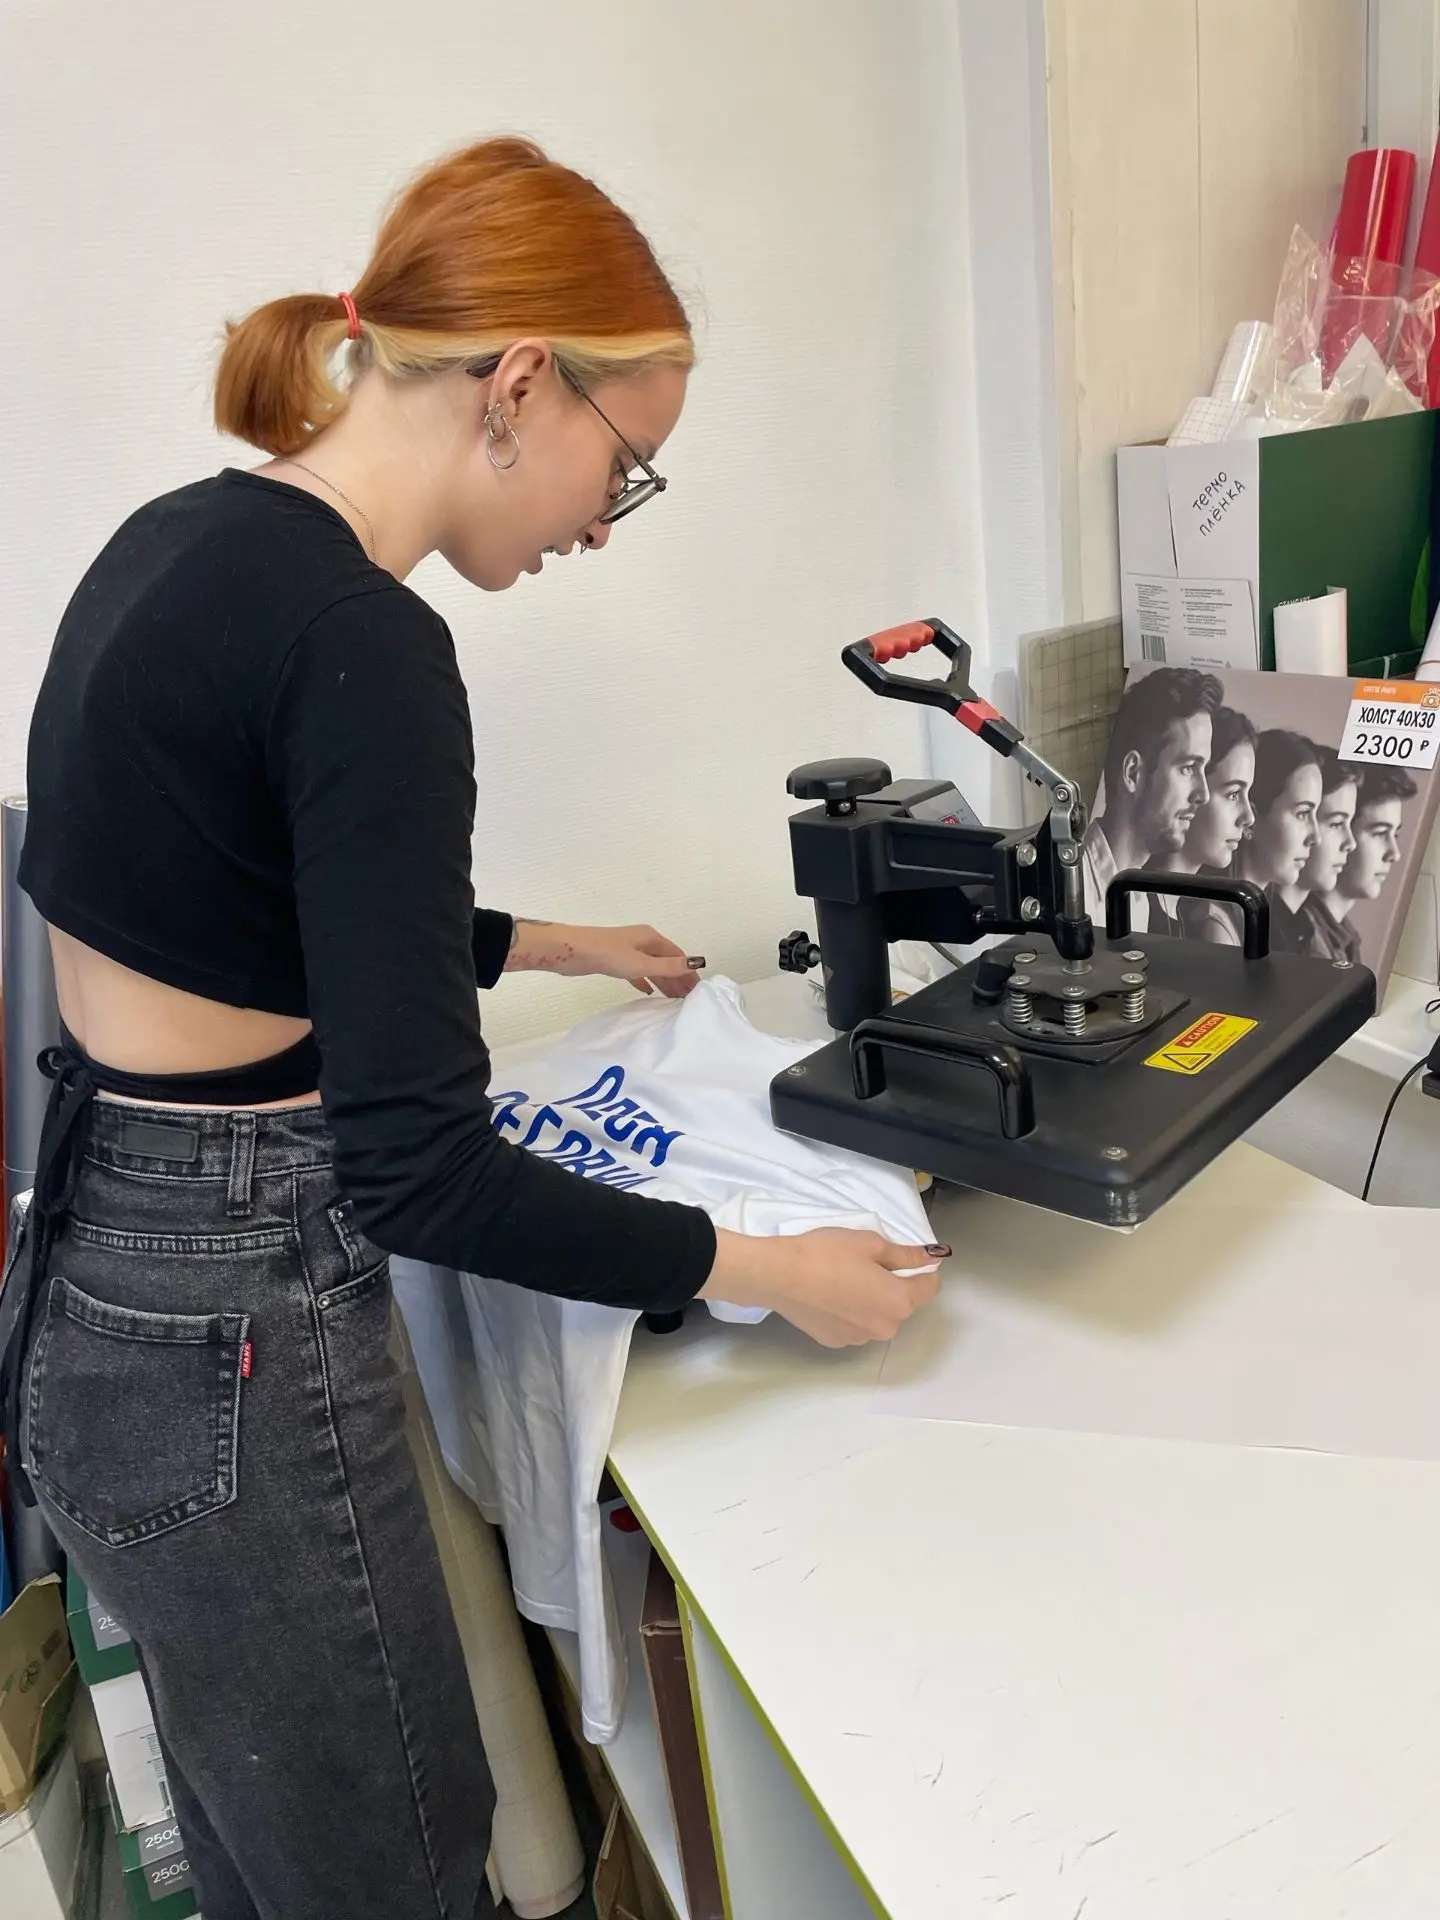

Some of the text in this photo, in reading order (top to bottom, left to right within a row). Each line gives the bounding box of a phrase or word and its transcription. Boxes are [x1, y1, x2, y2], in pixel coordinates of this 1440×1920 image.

[1358, 706, 1397, 726] ХОЛСТ
[1352, 733, 1413, 760] 2300
[1188, 1015, 1222, 1041] CAUTION
[151, 1859, 190, 1884] 2500
